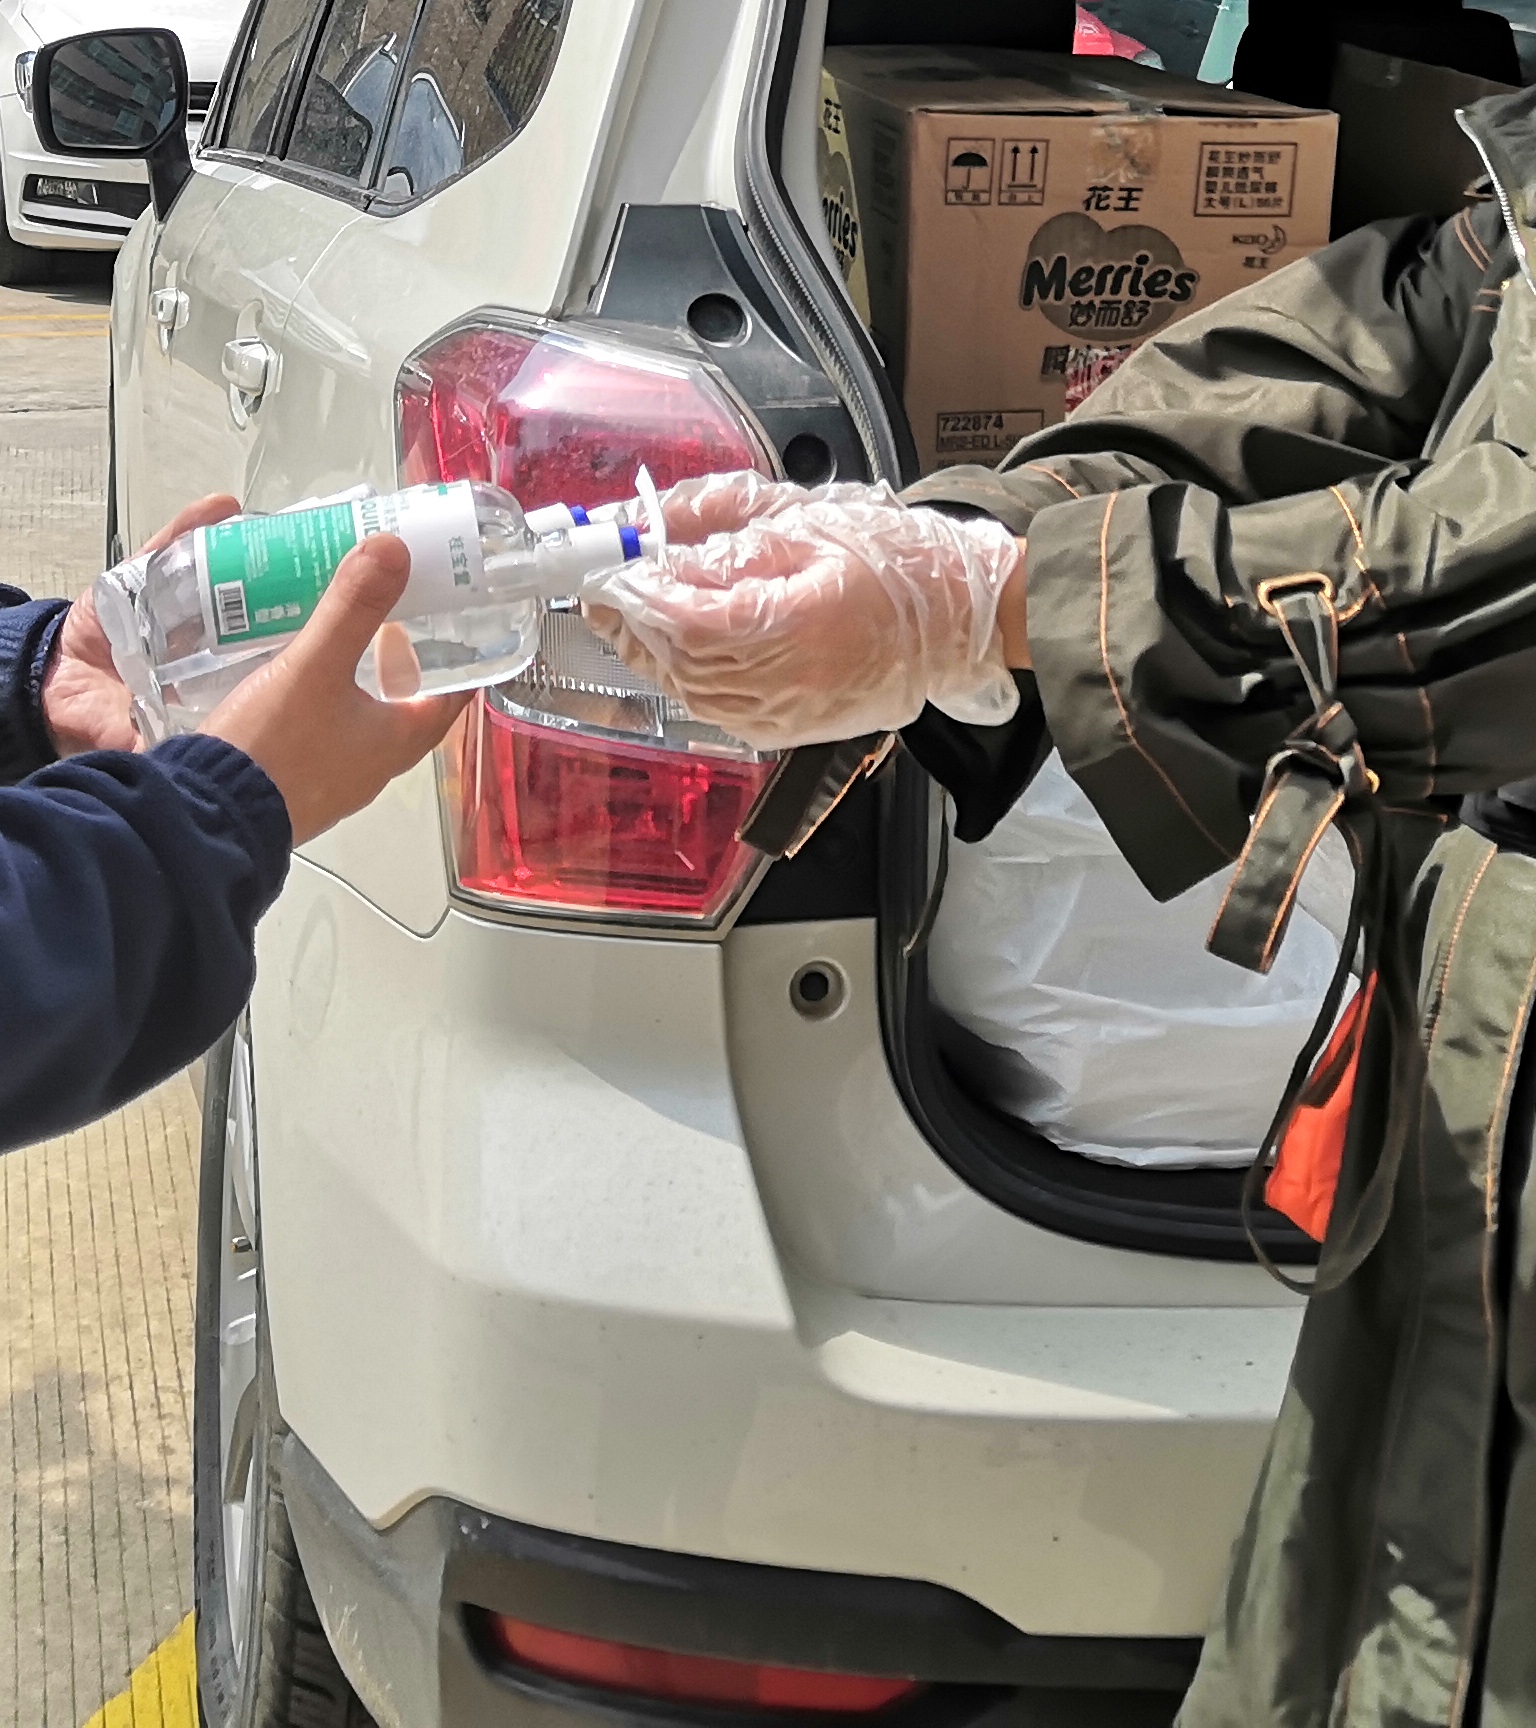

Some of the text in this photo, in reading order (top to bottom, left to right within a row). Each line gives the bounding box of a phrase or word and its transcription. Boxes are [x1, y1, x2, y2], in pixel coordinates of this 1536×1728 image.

[1083, 185, 1144, 213] 花王
[1022, 253, 1198, 307] Merries
[1068, 299, 1151, 328] 妙而舒
[940, 414, 1004, 432] 722874
